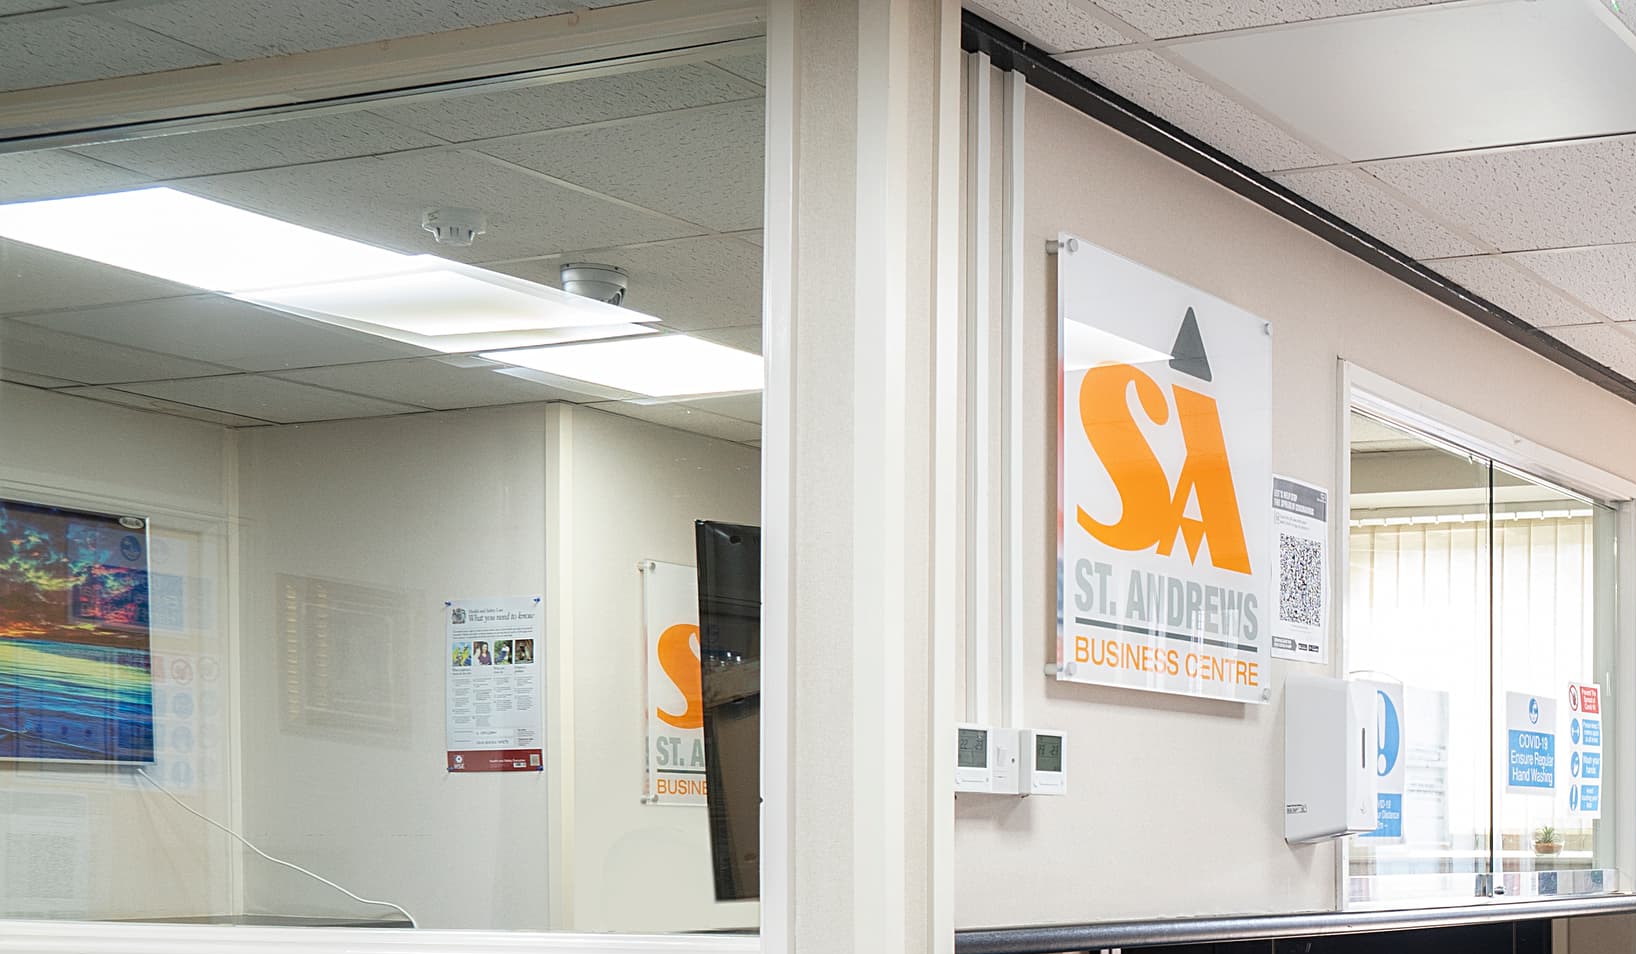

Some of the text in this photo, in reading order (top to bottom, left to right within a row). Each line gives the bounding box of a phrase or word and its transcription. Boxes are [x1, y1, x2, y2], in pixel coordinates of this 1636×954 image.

[1074, 558, 1259, 641] ST. ANDREWS
[1075, 635, 1259, 687] BUSINESS CENTRE
[656, 736, 685, 766] ST.
[1519, 733, 1549, 751] COVID-19
[1511, 750, 1554, 770] Ensure Regular
[657, 779, 708, 795] BUSINE
[1512, 766, 1553, 787] Hand Washing
